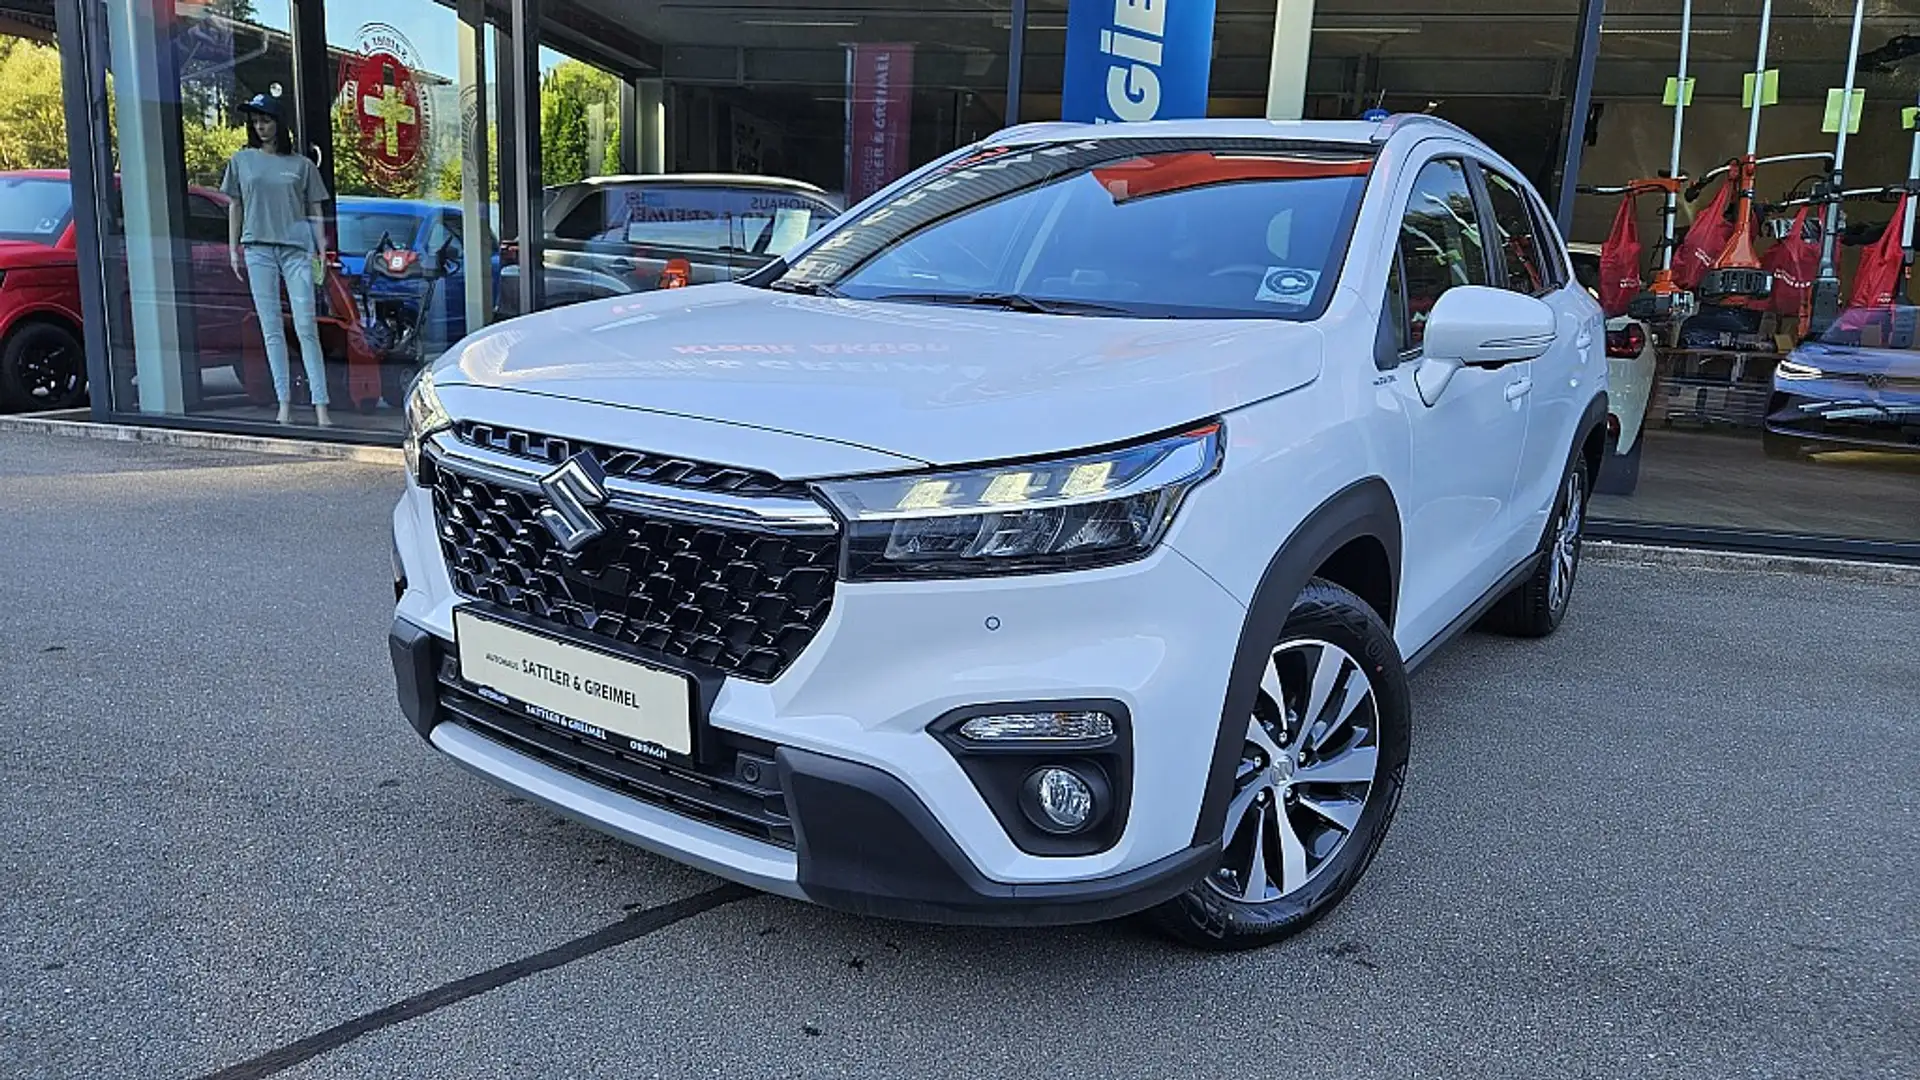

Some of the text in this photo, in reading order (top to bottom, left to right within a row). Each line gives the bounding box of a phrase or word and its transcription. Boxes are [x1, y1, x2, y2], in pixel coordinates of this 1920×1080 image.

[522, 658, 570, 688] SATTLER
[573, 676, 581, 691] &
[584, 679, 640, 709] GREIMEL
[525, 704, 560, 724] SATTLER
